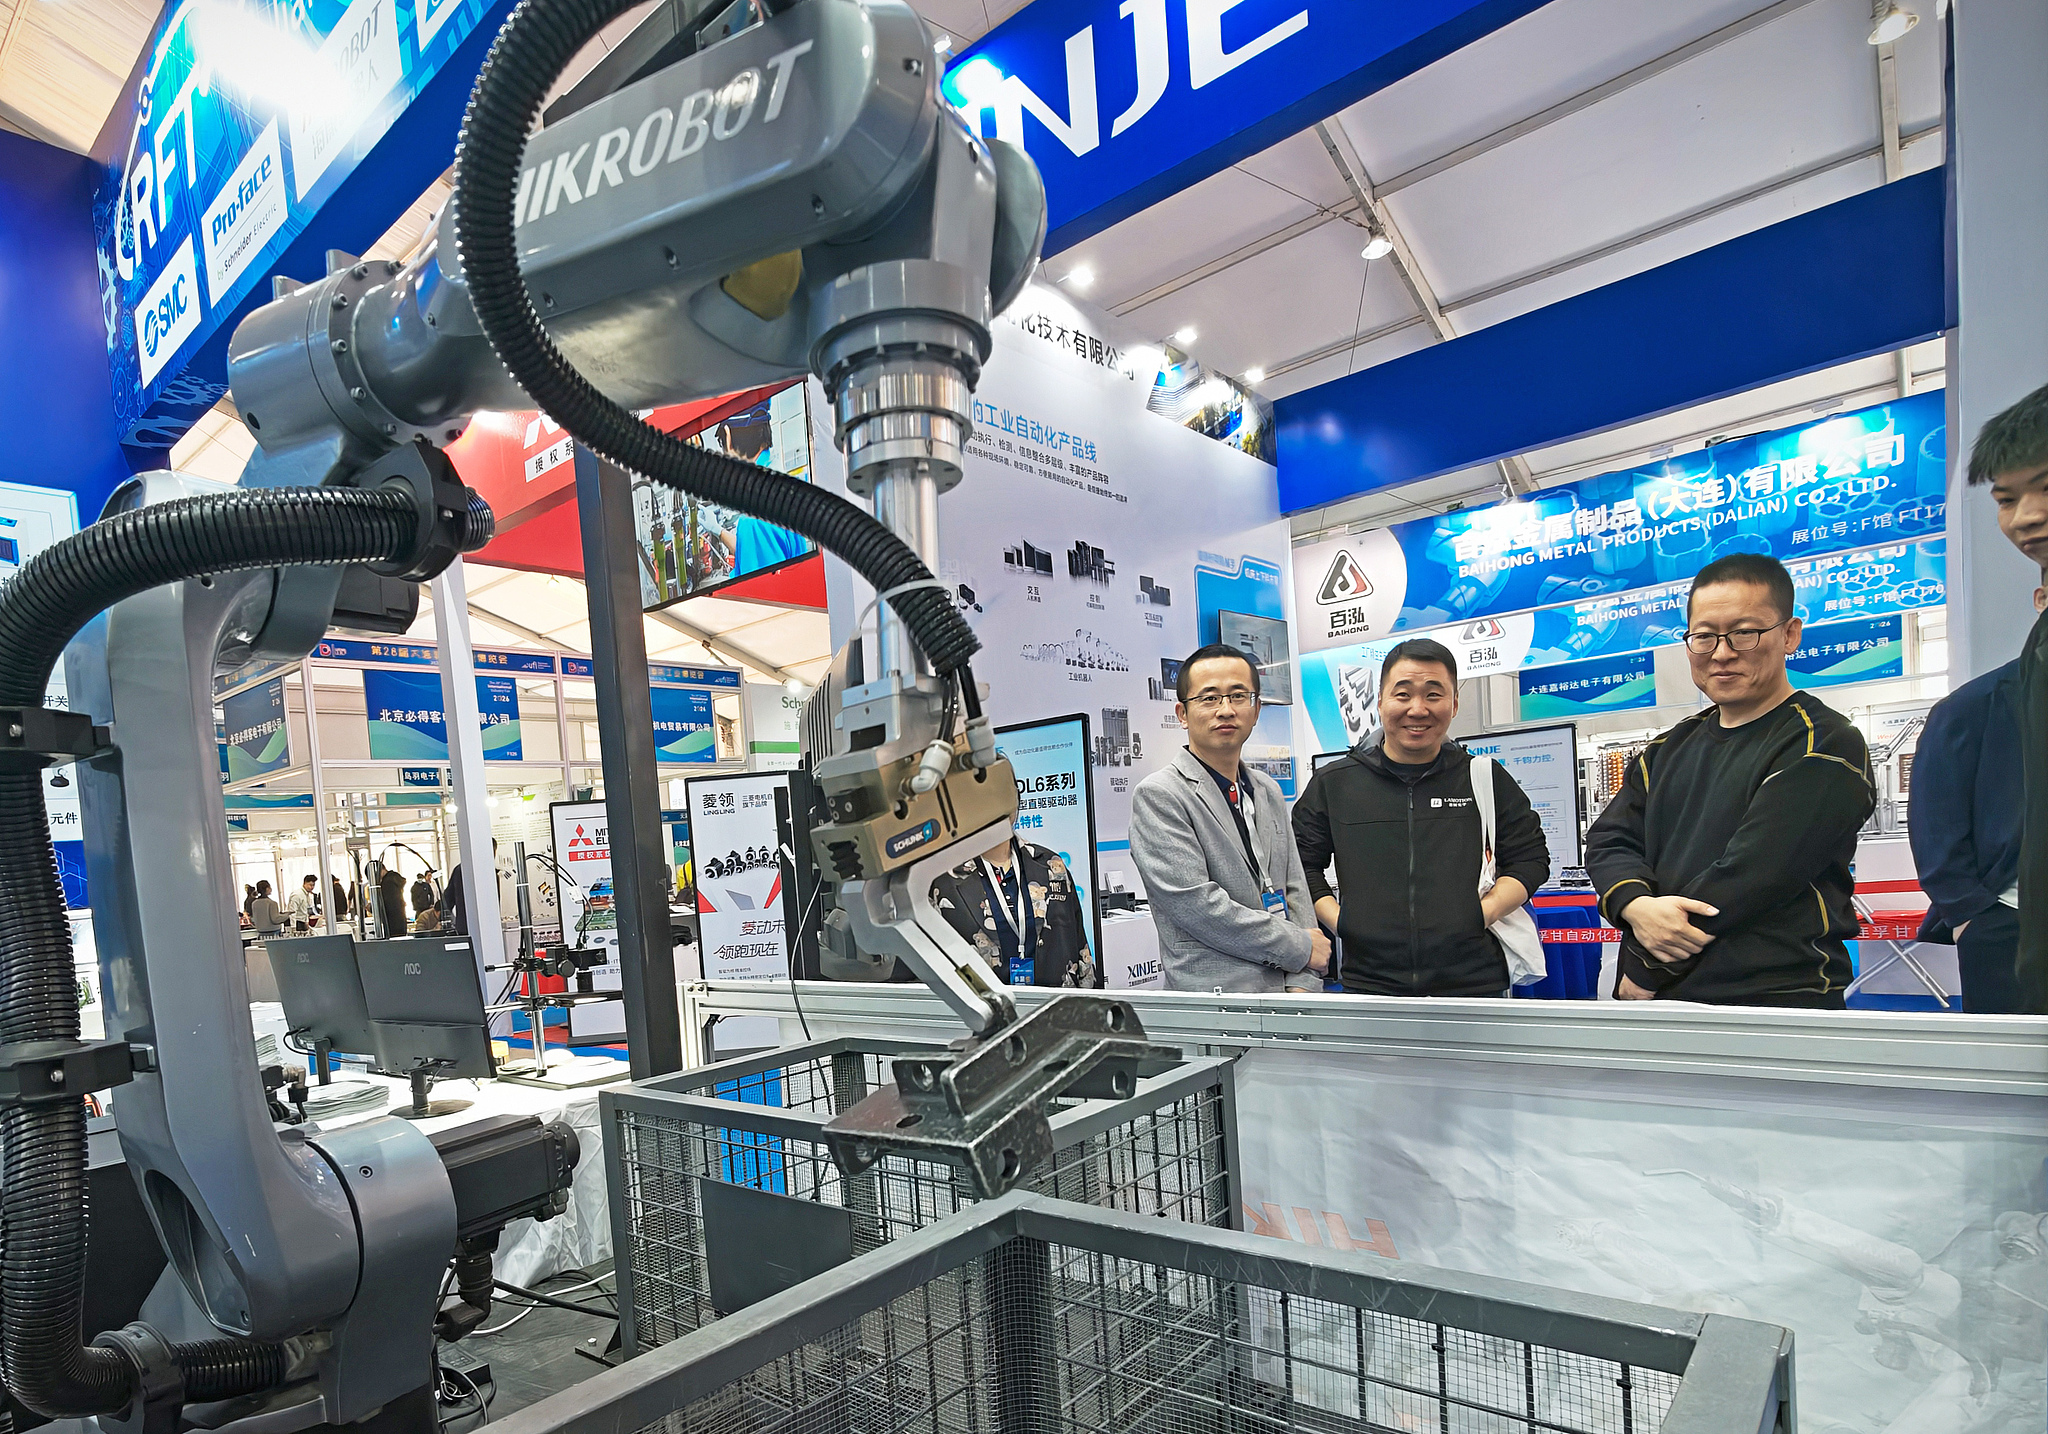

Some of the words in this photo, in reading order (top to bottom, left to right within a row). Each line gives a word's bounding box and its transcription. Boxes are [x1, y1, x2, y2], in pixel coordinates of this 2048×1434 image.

[211, 153, 273, 248] Pro-face
[216, 265, 225, 282] by
[224, 232, 253, 272] Schneider
[253, 202, 278, 238] Electric
[158, 273, 189, 338] SMC
[1458, 550, 1535, 579] BAIHONG
[1538, 539, 1598, 563] METAL
[1602, 518, 1702, 551] PRODUCTS
[1705, 494, 1789, 531] (DALIAN)
[1847, 474, 1898, 498] LTD.
[1864, 562, 1902, 576] LTD.
[1900, 583, 1945, 599] FT170
[1329, 606, 1366, 630] 百泓
[1576, 605, 1639, 627] BAIHONG
[1640, 597, 1685, 615] METAL
[1327, 624, 1370, 639] BAIHONG
[1469, 646, 1498, 664] 百泓
[1466, 660, 1502, 671] BAIHONG
[1528, 670, 1646, 696] 大连嘉裕达电子有限公司
[1467, 744, 1502, 757] XINJE
[702, 792, 735, 809] 菱领
[742, 800, 769, 809] 旗下品牌
[50, 812, 78, 825] 元件
[893, 831, 925, 853] SCHUNK
[712, 940, 780, 960] 领跑现在
[1127, 959, 1158, 980] XINJE
